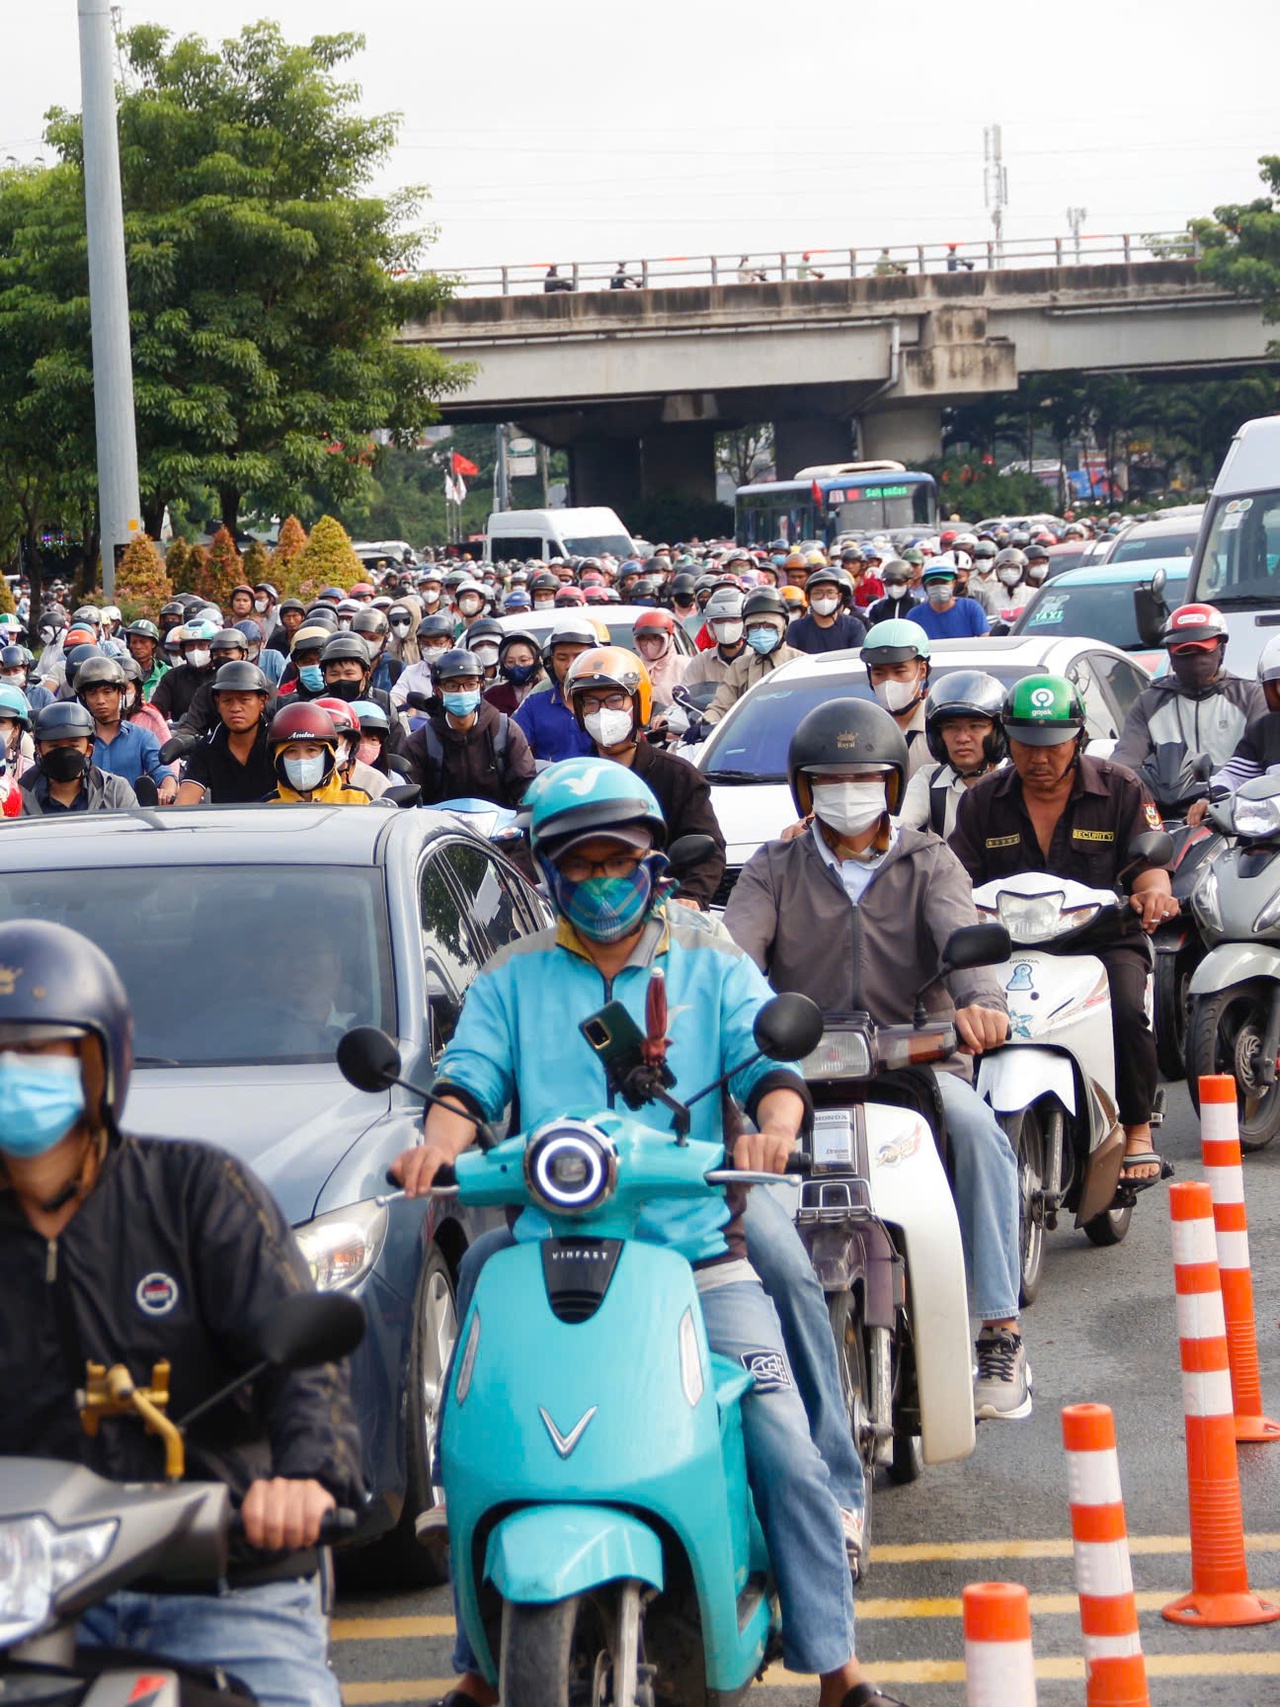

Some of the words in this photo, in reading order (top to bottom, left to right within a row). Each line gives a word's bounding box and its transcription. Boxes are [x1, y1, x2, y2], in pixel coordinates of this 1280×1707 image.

[1034, 610, 1064, 621] TAXI
[1031, 709, 1053, 717] gojek
[287, 731, 315, 740] Andes
[1073, 831, 1114, 840] SECURITY
[552, 1250, 608, 1260] VINFAST
